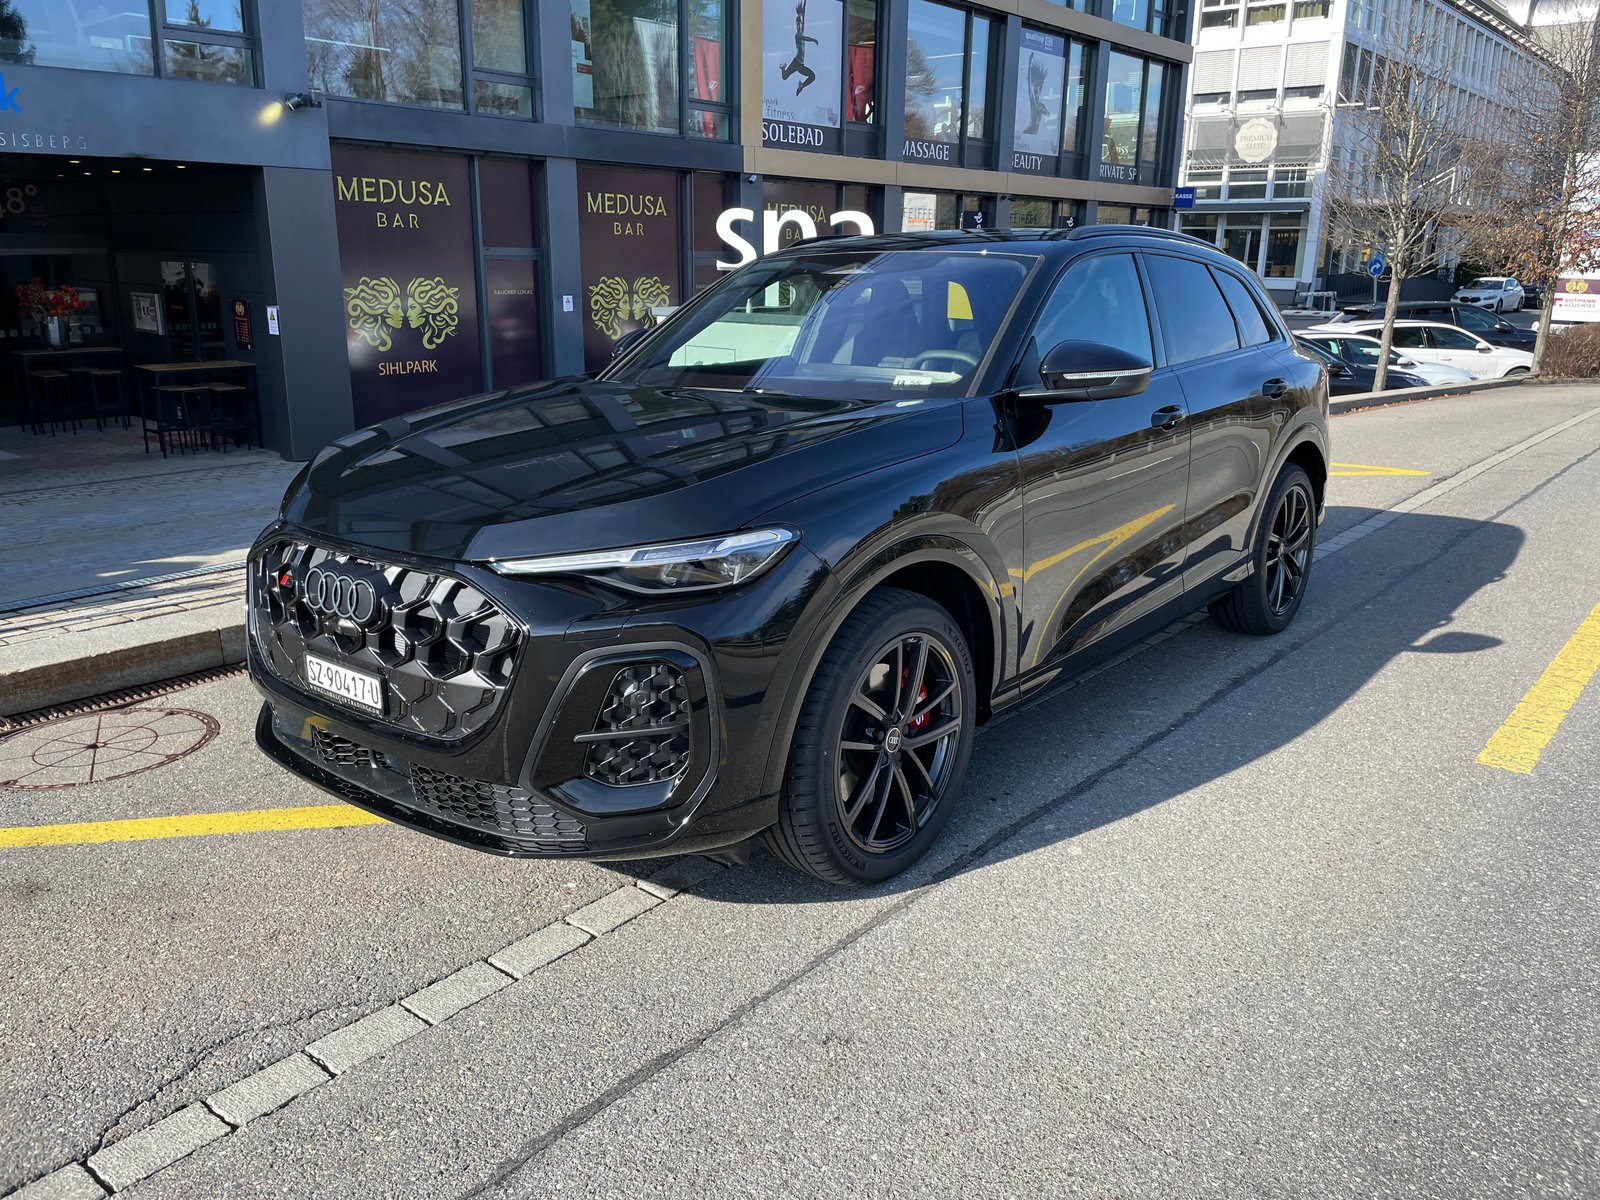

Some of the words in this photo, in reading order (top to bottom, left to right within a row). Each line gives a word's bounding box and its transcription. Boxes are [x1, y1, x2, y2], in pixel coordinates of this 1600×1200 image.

[767, 105, 795, 120] fitness
[762, 122, 824, 146] SOLEBAD
[1128, 167, 1141, 180] SP
[336, 175, 451, 206] MEDUSA
[587, 191, 668, 216] MEDUSA
[376, 212, 420, 228] BAR
[614, 222, 645, 236] BAR
[378, 360, 438, 376] SIHLPARK
